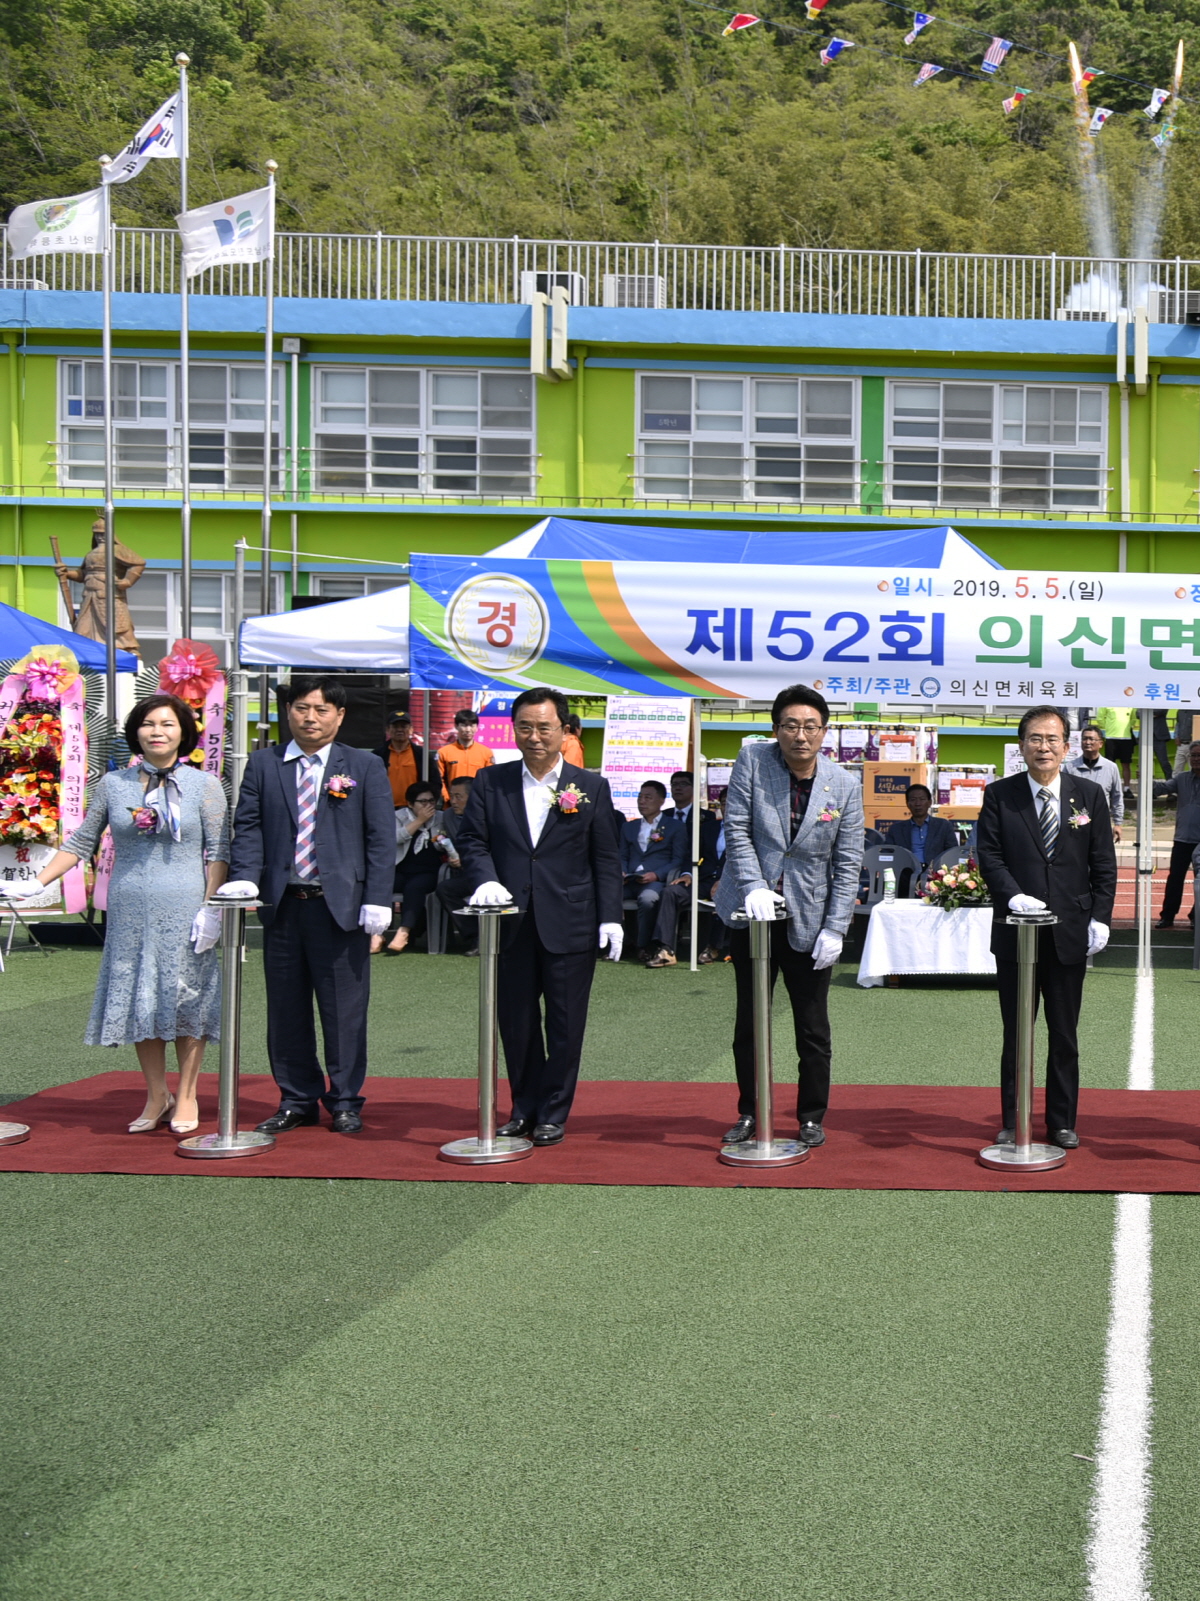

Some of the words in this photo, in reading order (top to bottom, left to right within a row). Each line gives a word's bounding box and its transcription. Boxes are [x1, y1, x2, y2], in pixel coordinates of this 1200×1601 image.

[478, 601, 519, 650] 경
[685, 606, 946, 666] 제52회
[14, 846, 30, 864] 祝
